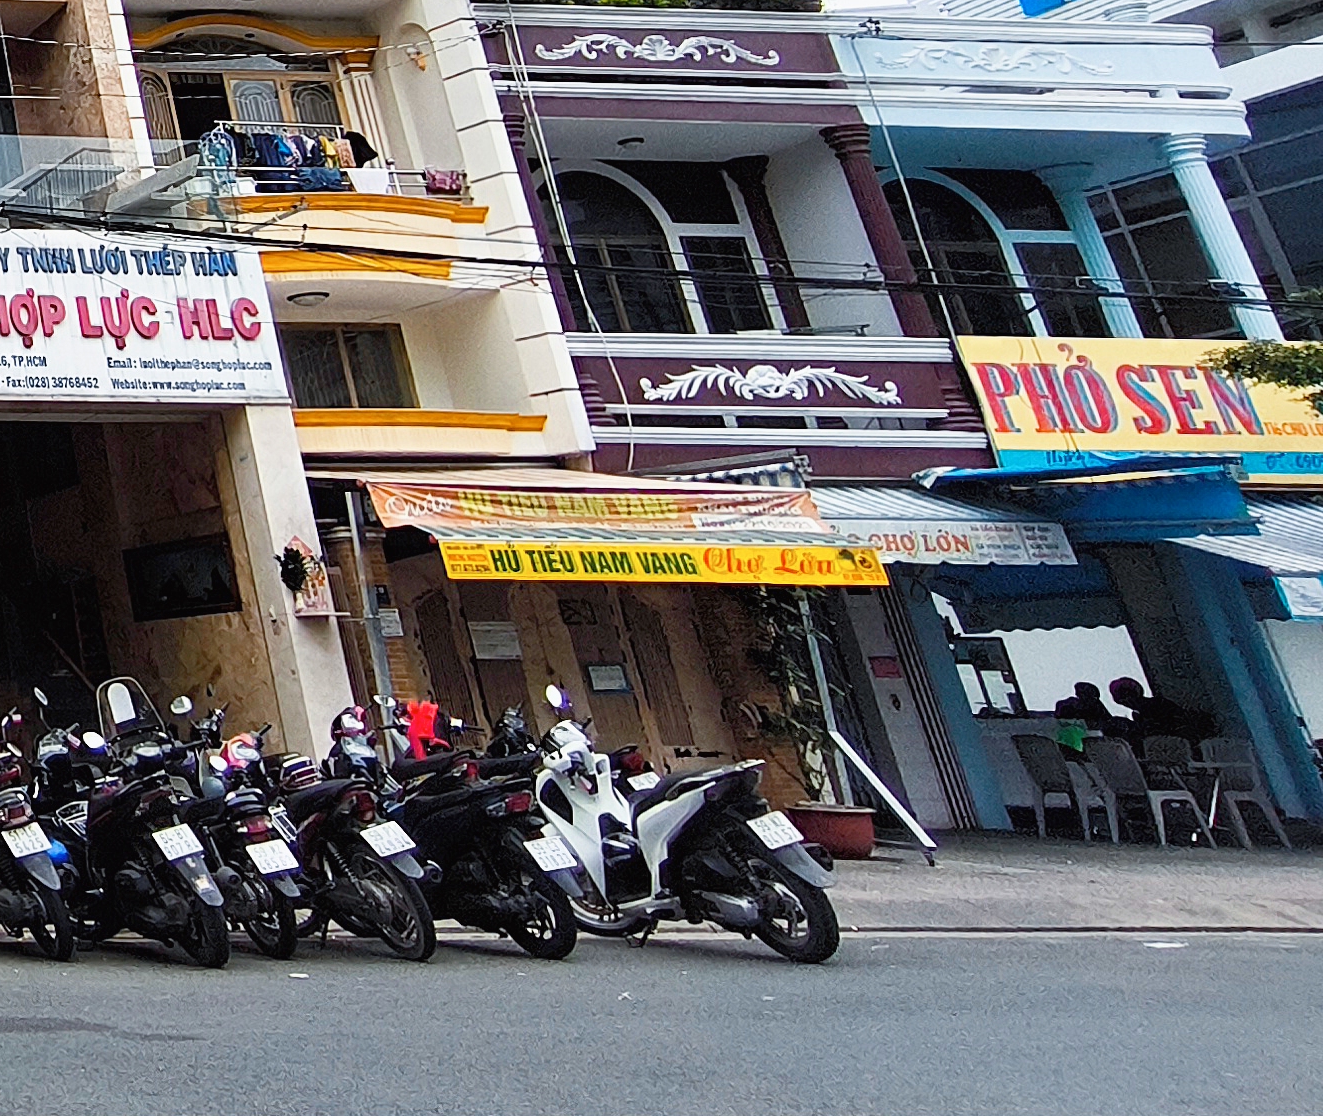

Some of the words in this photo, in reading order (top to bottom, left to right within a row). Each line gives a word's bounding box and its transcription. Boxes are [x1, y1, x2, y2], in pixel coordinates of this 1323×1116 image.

[16, 247, 77, 274] TNHH
[130, 244, 187, 276] THÉP
[190, 246, 239, 277] HÀN
[76, 288, 160, 350] LỰC
[177, 297, 262, 341] HLC
[971, 343, 1118, 435] PHỞ
[1116, 363, 1265, 436] SEN
[489, 541, 523, 573] HỦ
[525, 542, 576, 573] TIẾU
[580, 550, 635, 574] NAM
[637, 552, 700, 576] VANG
[702, 547, 766, 580] Chợ
[869, 530, 918, 557] CHỢ
[922, 529, 972, 554] LỚN
